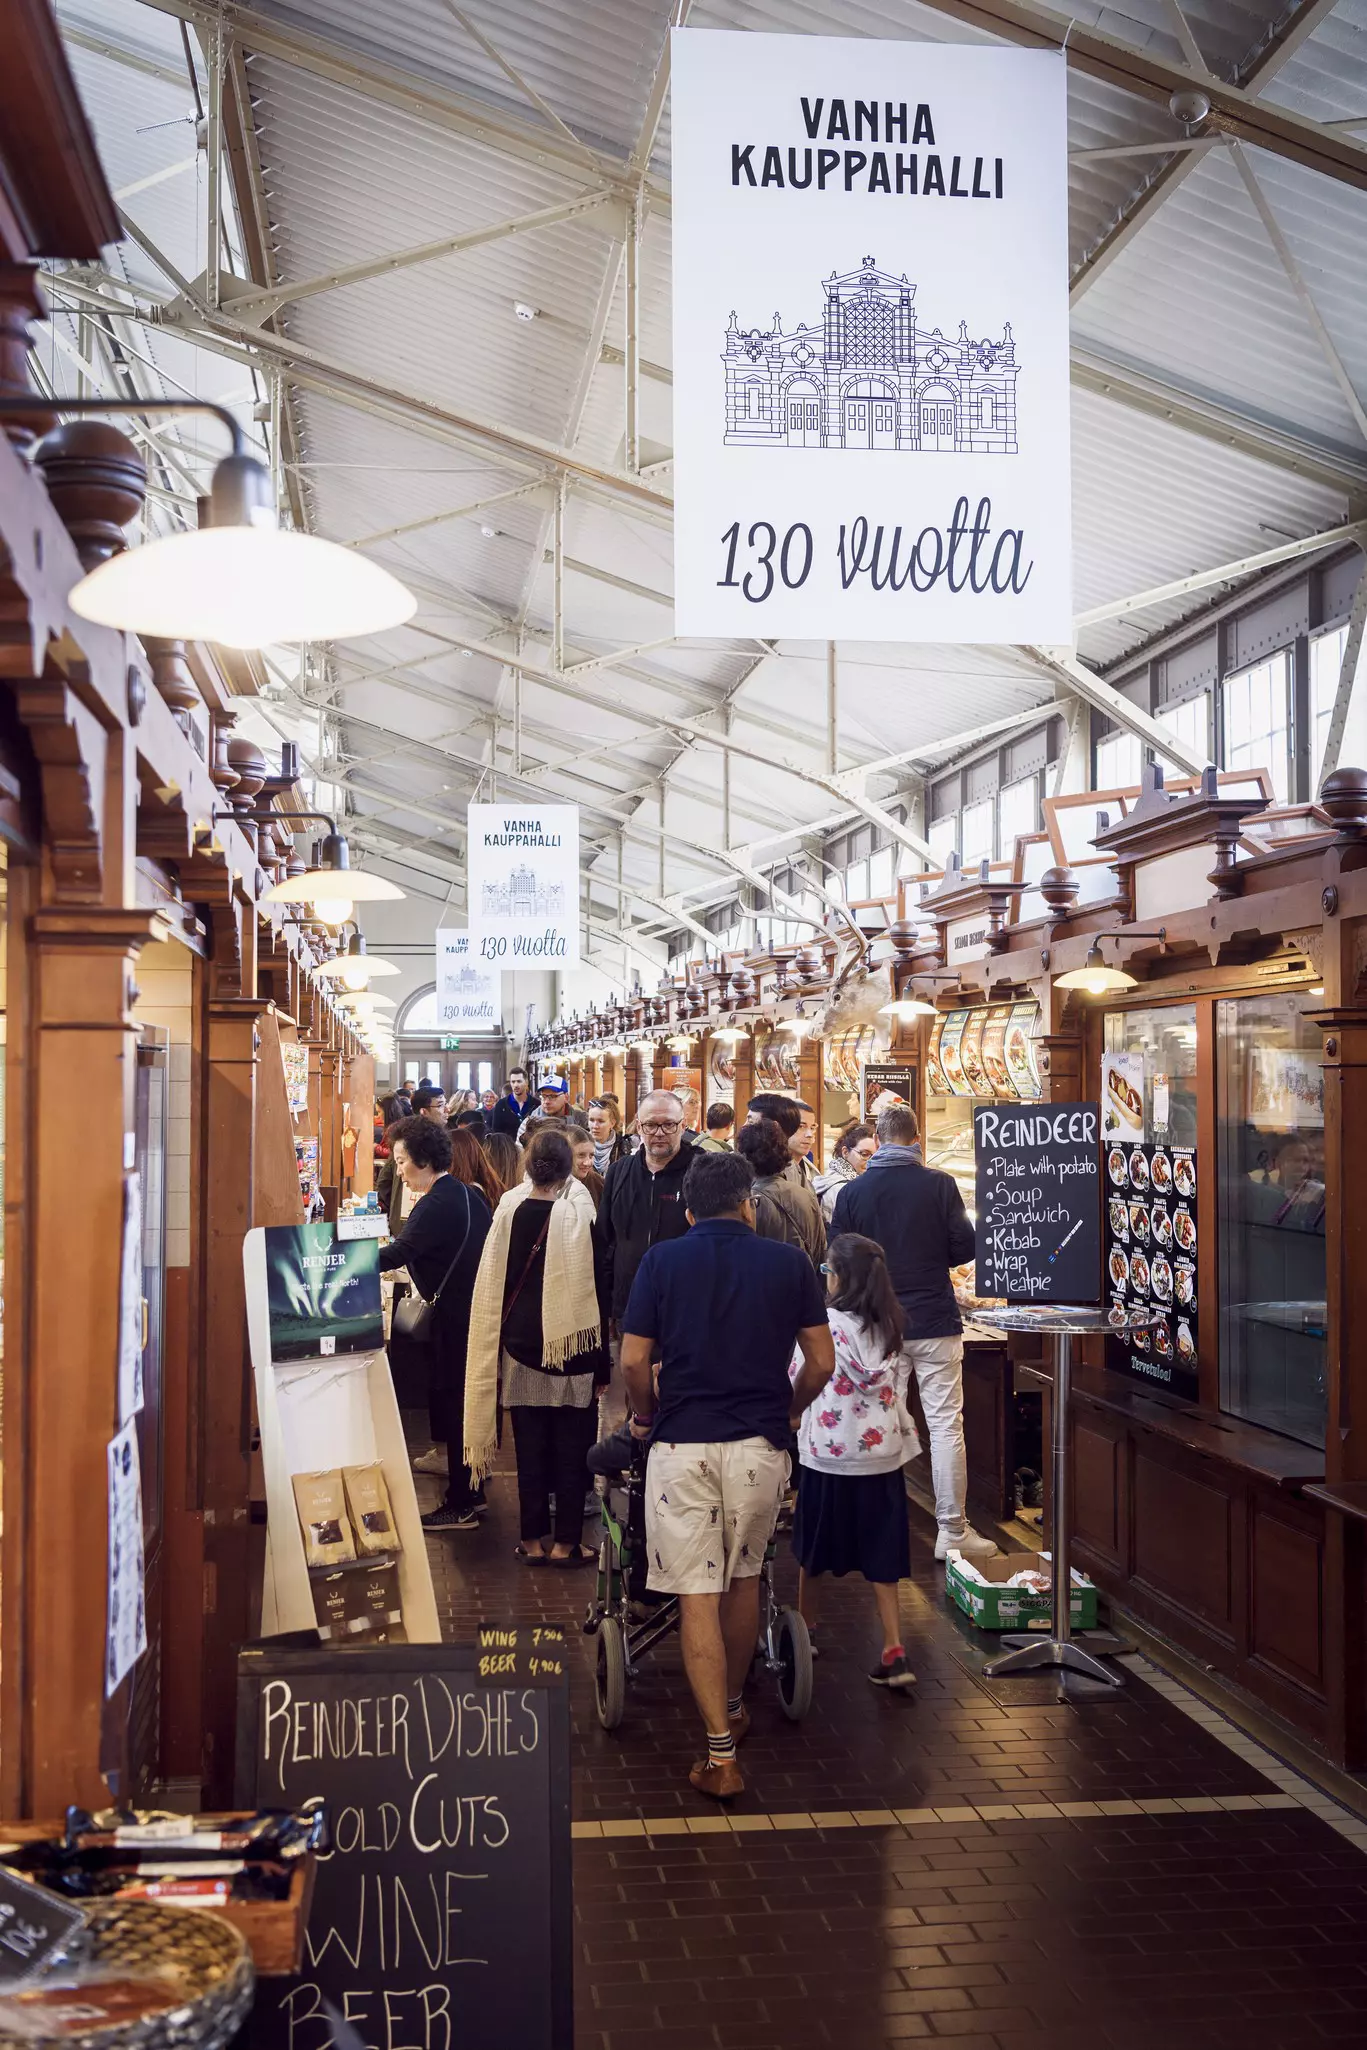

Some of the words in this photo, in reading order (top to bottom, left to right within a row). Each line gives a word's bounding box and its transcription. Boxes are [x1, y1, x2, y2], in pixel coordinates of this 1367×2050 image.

[800, 96, 935, 145] VANHA
[731, 144, 1004, 199] KAUPPAHALLI
[716, 521, 813, 603] 130
[837, 495, 1034, 595] vuotta
[504, 820, 542, 832] VANHA
[484, 834, 561, 847] KAUPPAHALLI
[480, 936, 507, 960] 130
[513, 928, 567, 956] vuotta
[444, 1005, 460, 1020] 130
[976, 1111, 1097, 1149] REINDEER
[990, 1157, 1026, 1177] Plate
[1030, 1156, 1056, 1175] with
[1058, 1155, 1097, 1184] potato
[995, 1181, 1042, 1208] Soup
[990, 1202, 1070, 1228] Sandwich
[993, 1226, 1041, 1251] Kebab
[302, 1254, 347, 1268] RENJER
[993, 1252, 1028, 1273] Wrap
[993, 1267, 1052, 1296] Meatpie
[1131, 1355, 1172, 1382] Tervetuloa!
[480, 1630, 517, 1648] WINE
[478, 1652, 516, 1676] BEER
[262, 1680, 414, 1791] REINDEER
[414, 1674, 539, 1762] DISHES
[409, 1772, 510, 1853] CUTS
[304, 1871, 488, 1971] WINE
[278, 1983, 451, 2050] BEER
